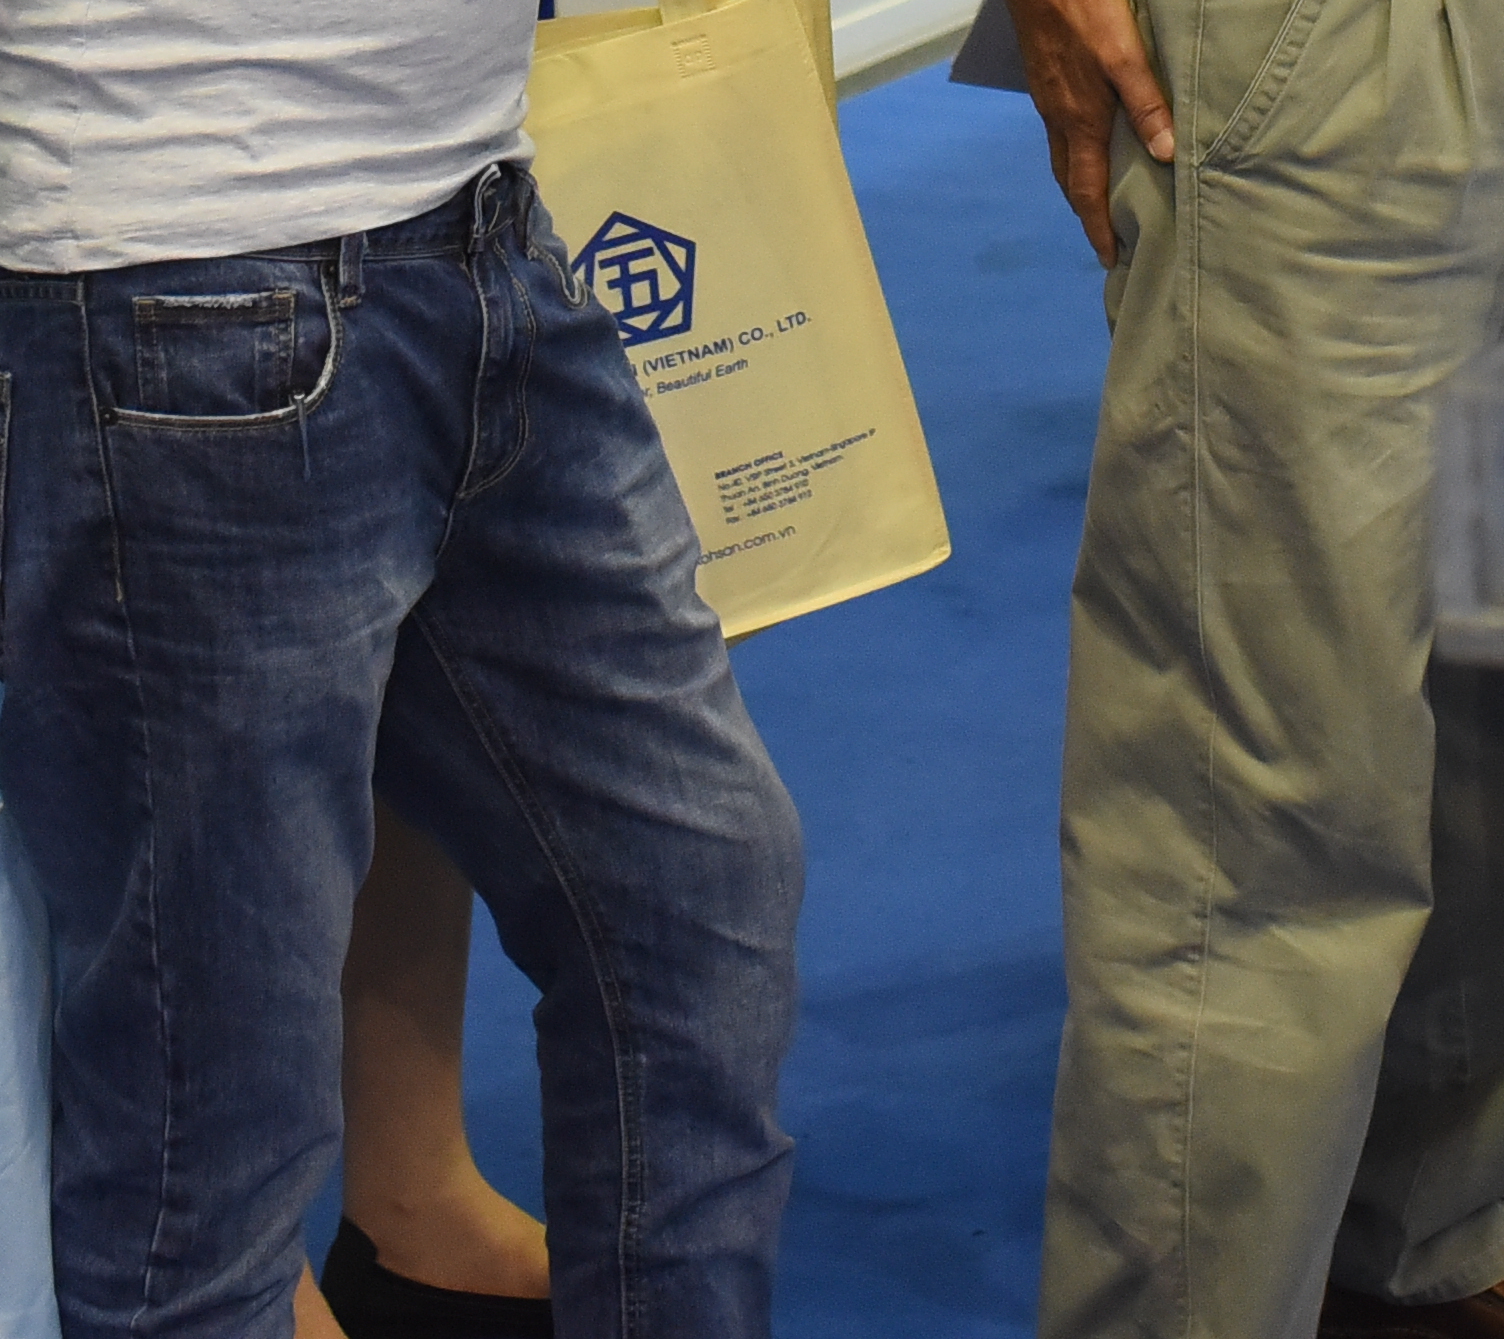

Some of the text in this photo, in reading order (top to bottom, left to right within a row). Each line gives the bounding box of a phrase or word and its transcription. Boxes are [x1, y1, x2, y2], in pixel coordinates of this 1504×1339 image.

[643, 335, 735, 378] (VIETNAM)
[775, 310, 813, 336] LTD.
[657, 370, 713, 397] Beautiful
[715, 356, 749, 380] Earth
